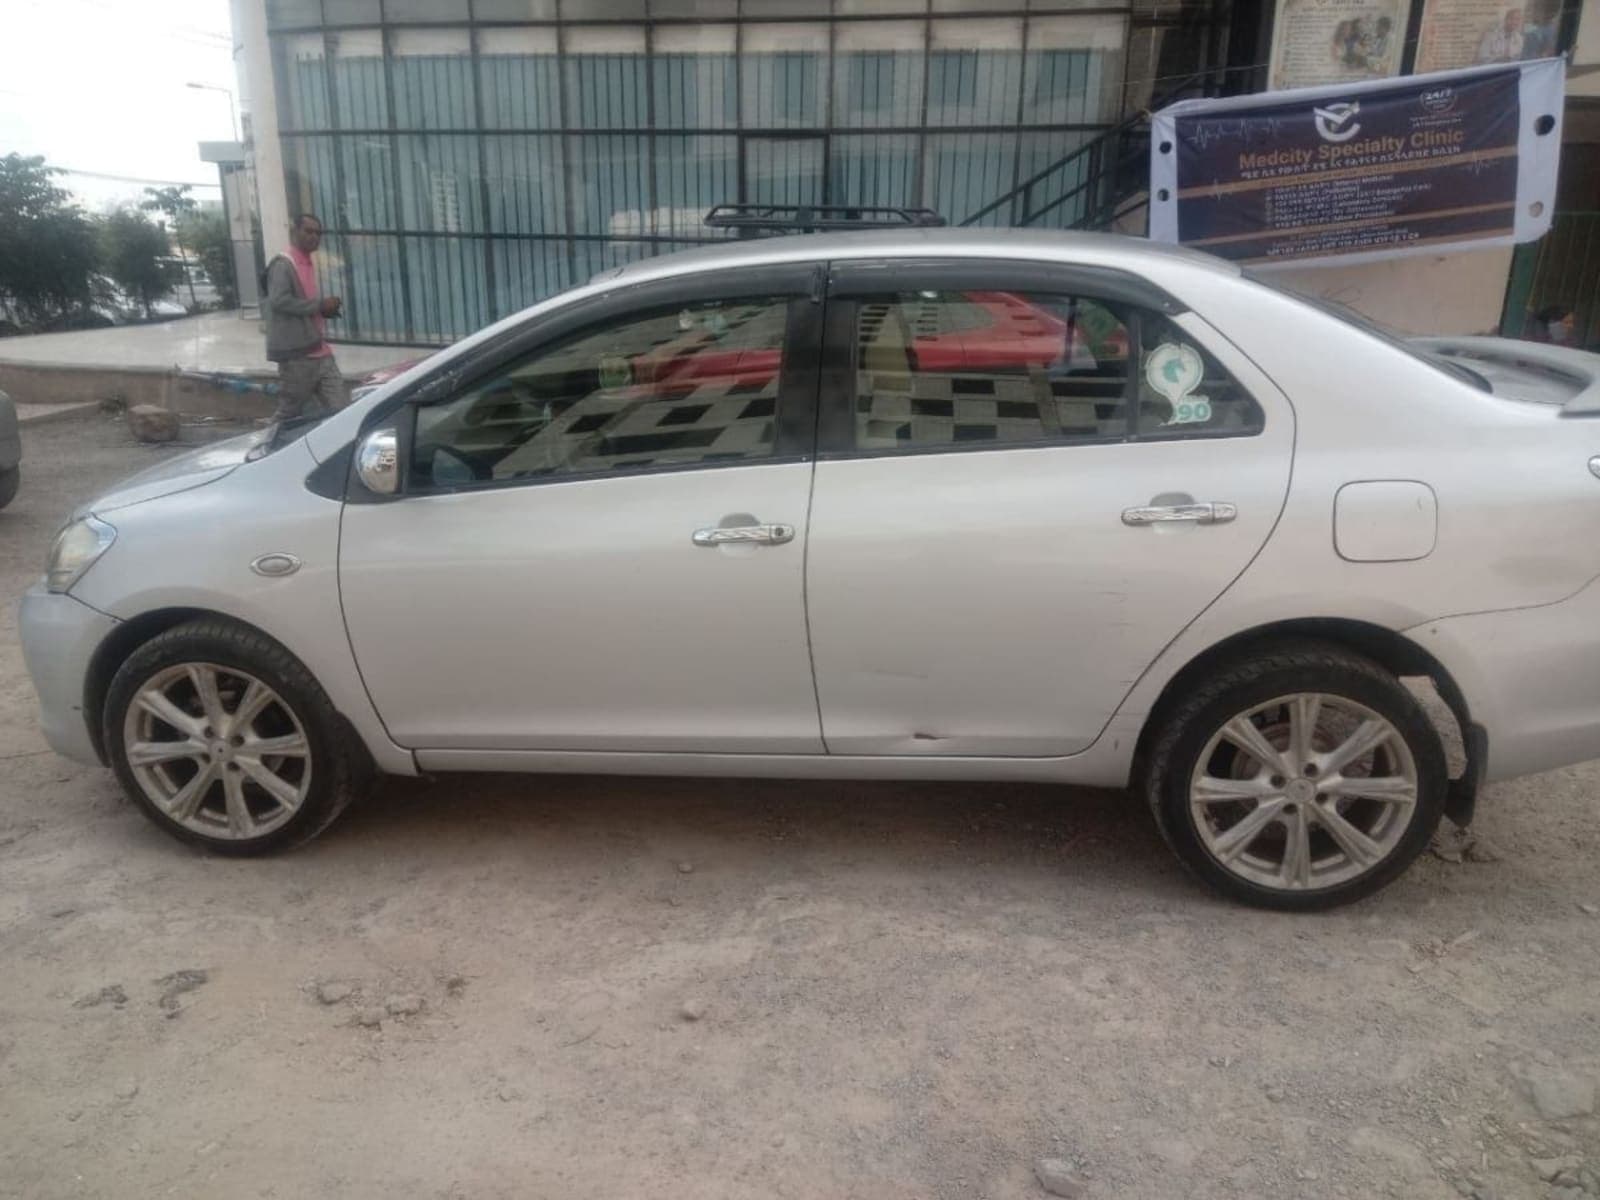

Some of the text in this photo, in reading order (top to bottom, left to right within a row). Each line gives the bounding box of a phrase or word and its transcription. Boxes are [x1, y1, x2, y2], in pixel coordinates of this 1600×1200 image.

[1239, 129, 1465, 170] Medcity Specialty Clinic
